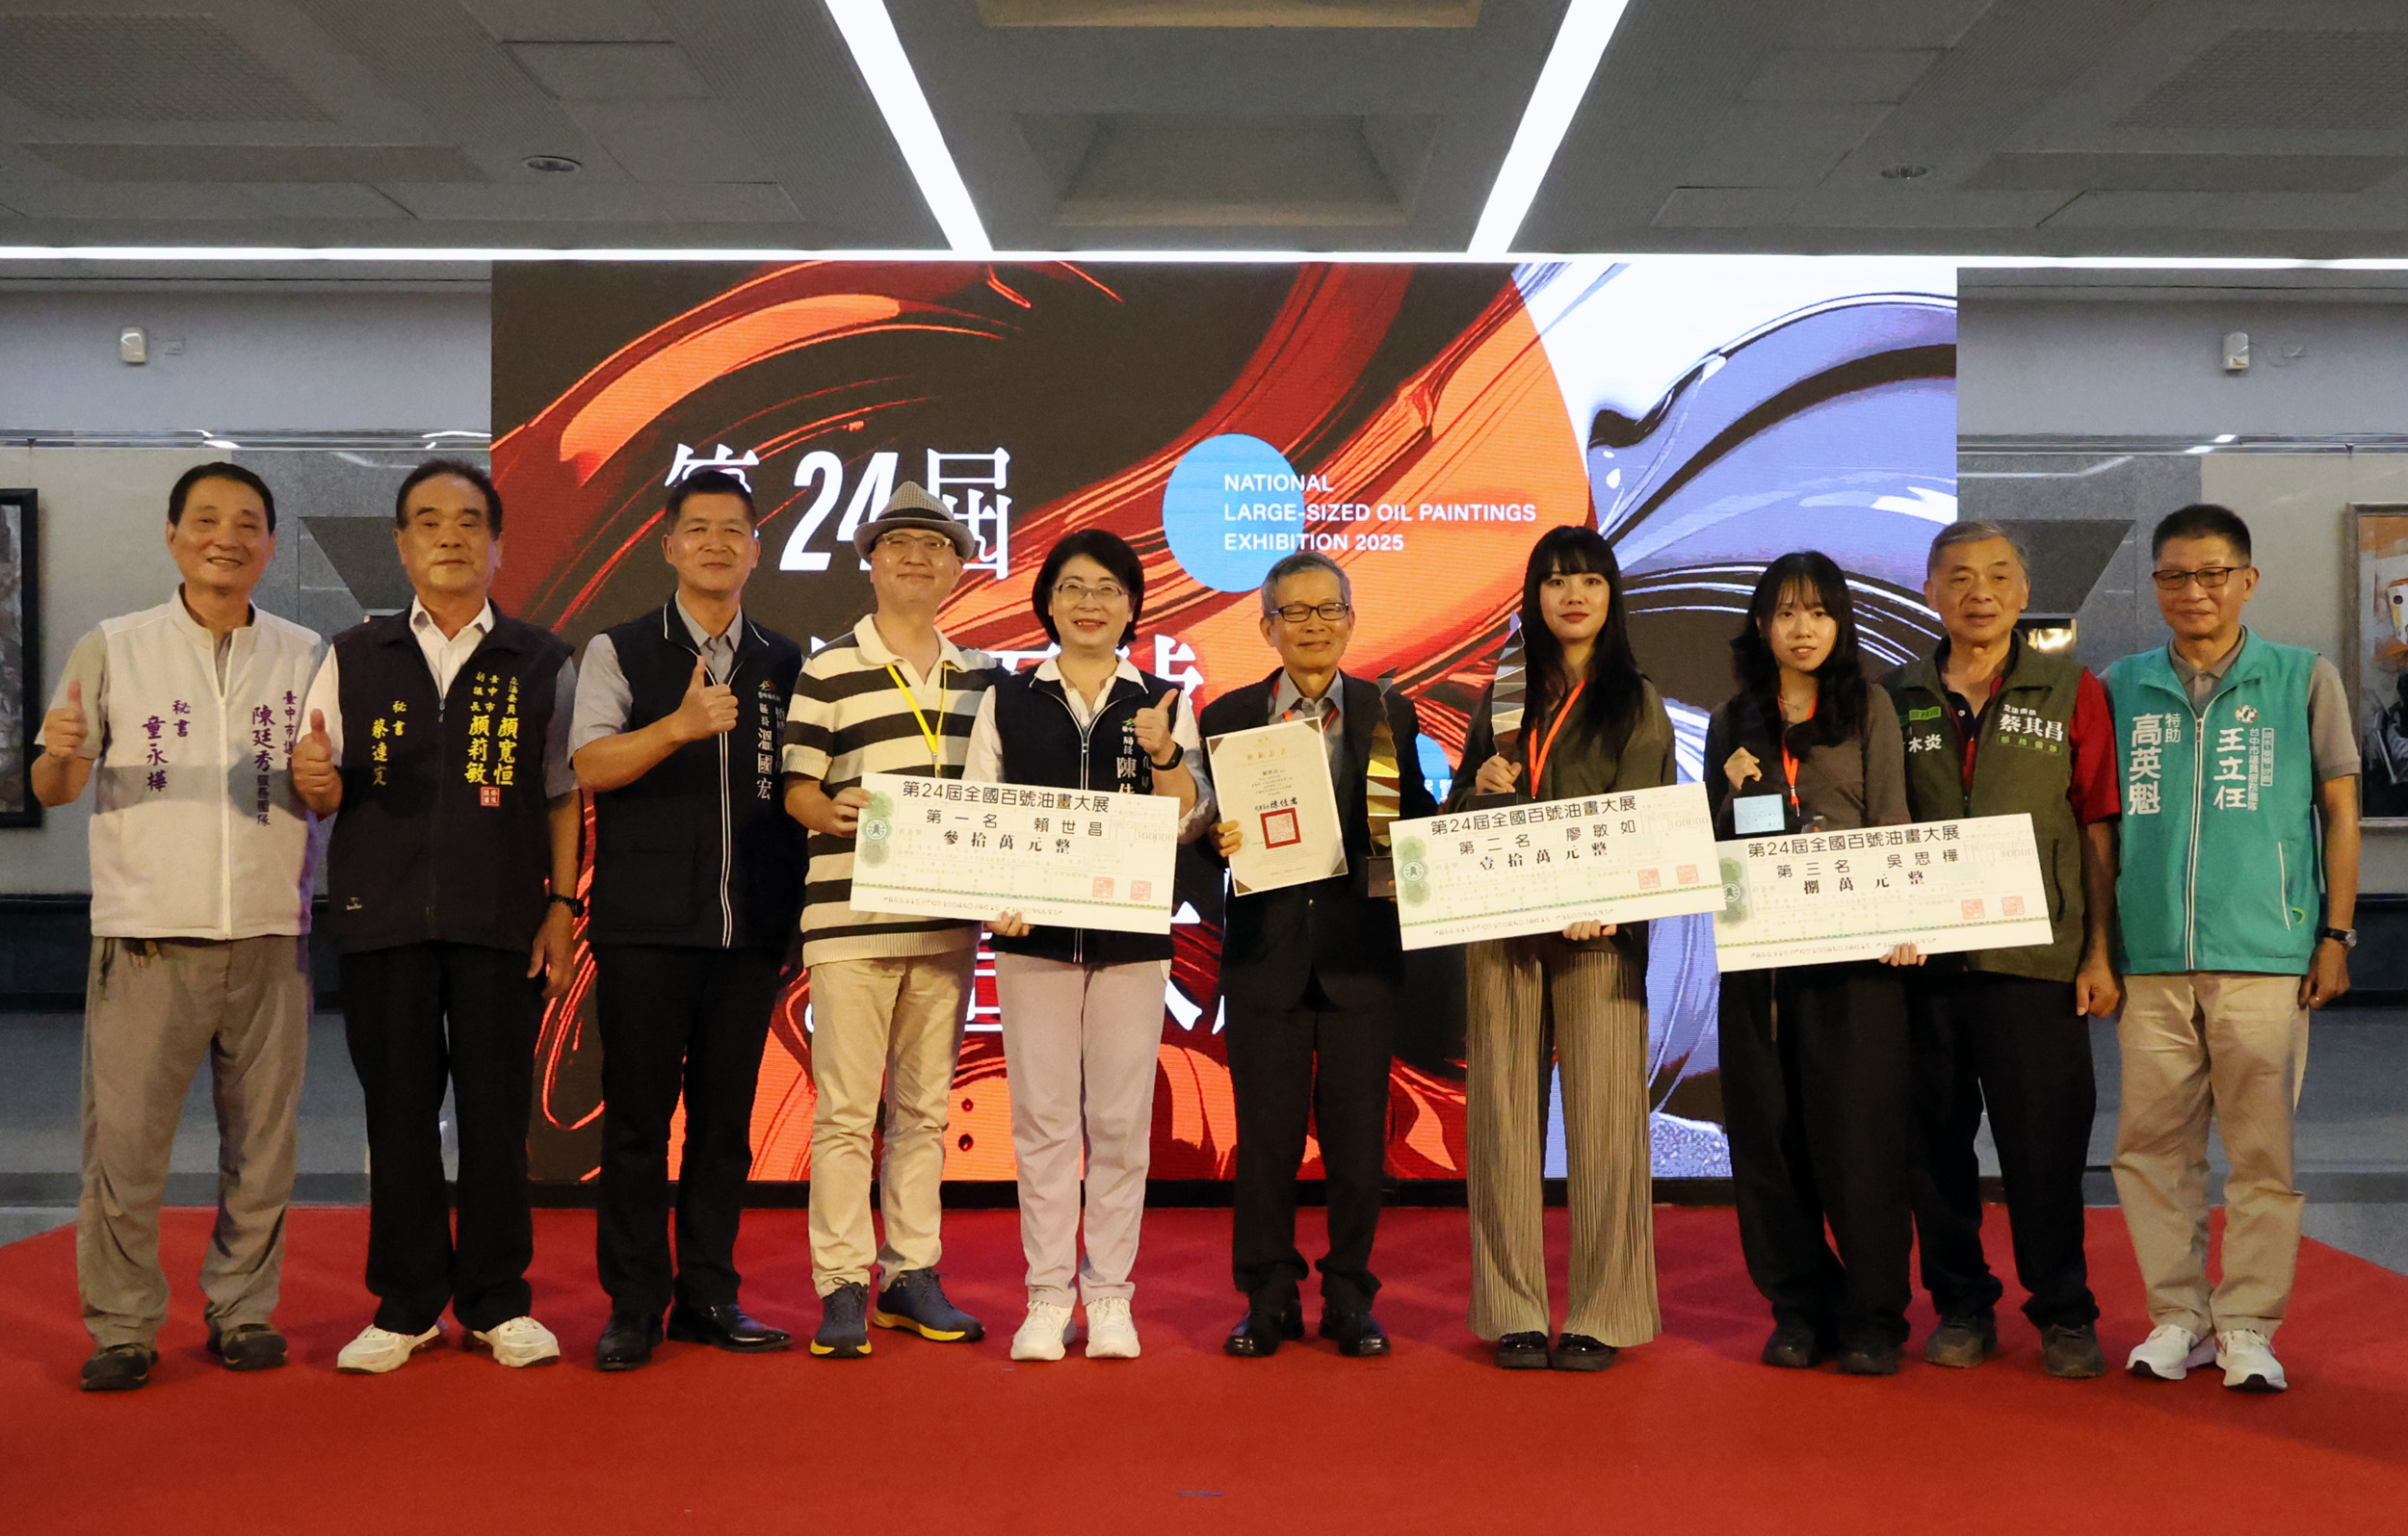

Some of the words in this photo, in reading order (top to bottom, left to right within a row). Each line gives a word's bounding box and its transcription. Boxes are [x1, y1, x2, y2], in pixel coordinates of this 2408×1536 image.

[1224, 474, 1334, 492] NATIONAL
[1224, 504, 1371, 522] LARGE-SIZED
[1376, 504, 1413, 522] OIL
[1420, 504, 1537, 522] PAINTINGS
[1224, 533, 1348, 551] EXHIBITION
[1355, 534, 1404, 551] 2025
[171, 700, 192, 737] 秘書
[391, 700, 407, 736] 秘書
[1999, 714, 2063, 742] 蔡其昌
[2164, 713, 2182, 742] 特助
[252, 704, 275, 771] 陳廷秀
[2128, 714, 2163, 816] 高英魁
[2213, 727, 2247, 810] 王立任
[902, 780, 1110, 813] 第24屆全國百號油畫大展
[927, 809, 998, 829] 第一名
[1034, 817, 1103, 837] 賴世昌
[1430, 795, 1637, 836] 第24屆全國百號油畫大展
[1458, 834, 1531, 855] 第二名
[1566, 820, 1636, 842] 廖敏如
[1748, 824, 1961, 858] 第24屆全國百號油畫大展
[1776, 859, 1850, 878] 第三名
[1887, 848, 1960, 870] 吳思樺
